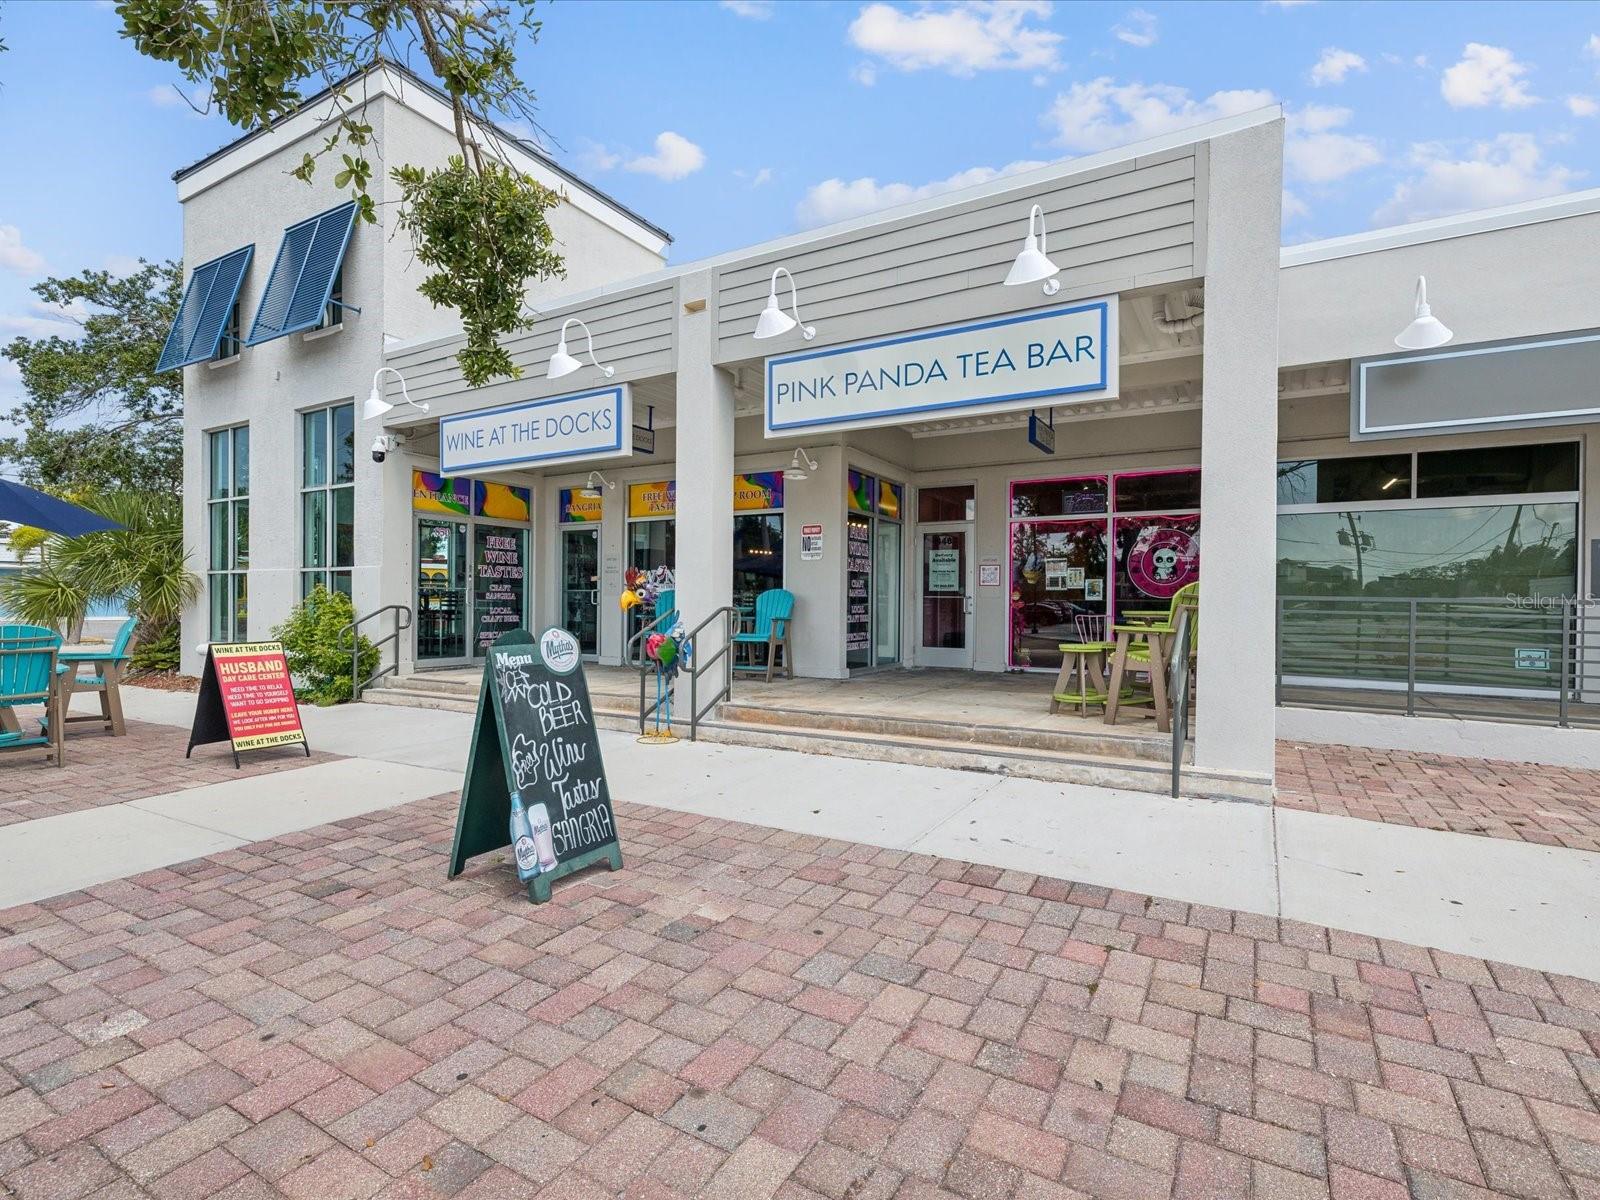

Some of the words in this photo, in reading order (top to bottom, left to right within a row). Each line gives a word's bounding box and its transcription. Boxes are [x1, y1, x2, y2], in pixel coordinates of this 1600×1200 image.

[777, 375, 837, 405] PINK
[844, 359, 948, 395] PANDA
[956, 348, 1016, 378] TEA
[1027, 335, 1096, 369] BAR
[446, 429, 485, 451] WINE
[488, 425, 507, 447] AT
[511, 420, 540, 443] THE
[545, 408, 612, 438] DOCKS
[739, 488, 772, 500] ROOM
[565, 502, 602, 513] SANGRIA
[486, 536, 516, 550] FREE
[484, 550, 518, 565] WINE
[478, 565, 524, 579] TASTES
[214, 646, 235, 654] WINE
[259, 644, 281, 652] DOCKS
[544, 639, 574, 660] Mythos
[495, 652, 533, 666] Menu
[219, 659, 284, 675] HUSBAND
[222, 674, 237, 683] DAY
[238, 673, 257, 682] CARE
[258, 671, 285, 680] CENTER
[527, 681, 572, 709] COLD
[538, 699, 588, 736] BEER
[235, 739, 255, 748] WINE
[256, 739, 266, 747] AT
[266, 736, 279, 745] THE
[280, 733, 302, 742] DOCKS
[540, 736, 587, 780] Wine
[551, 803, 614, 856] SANGRIA
